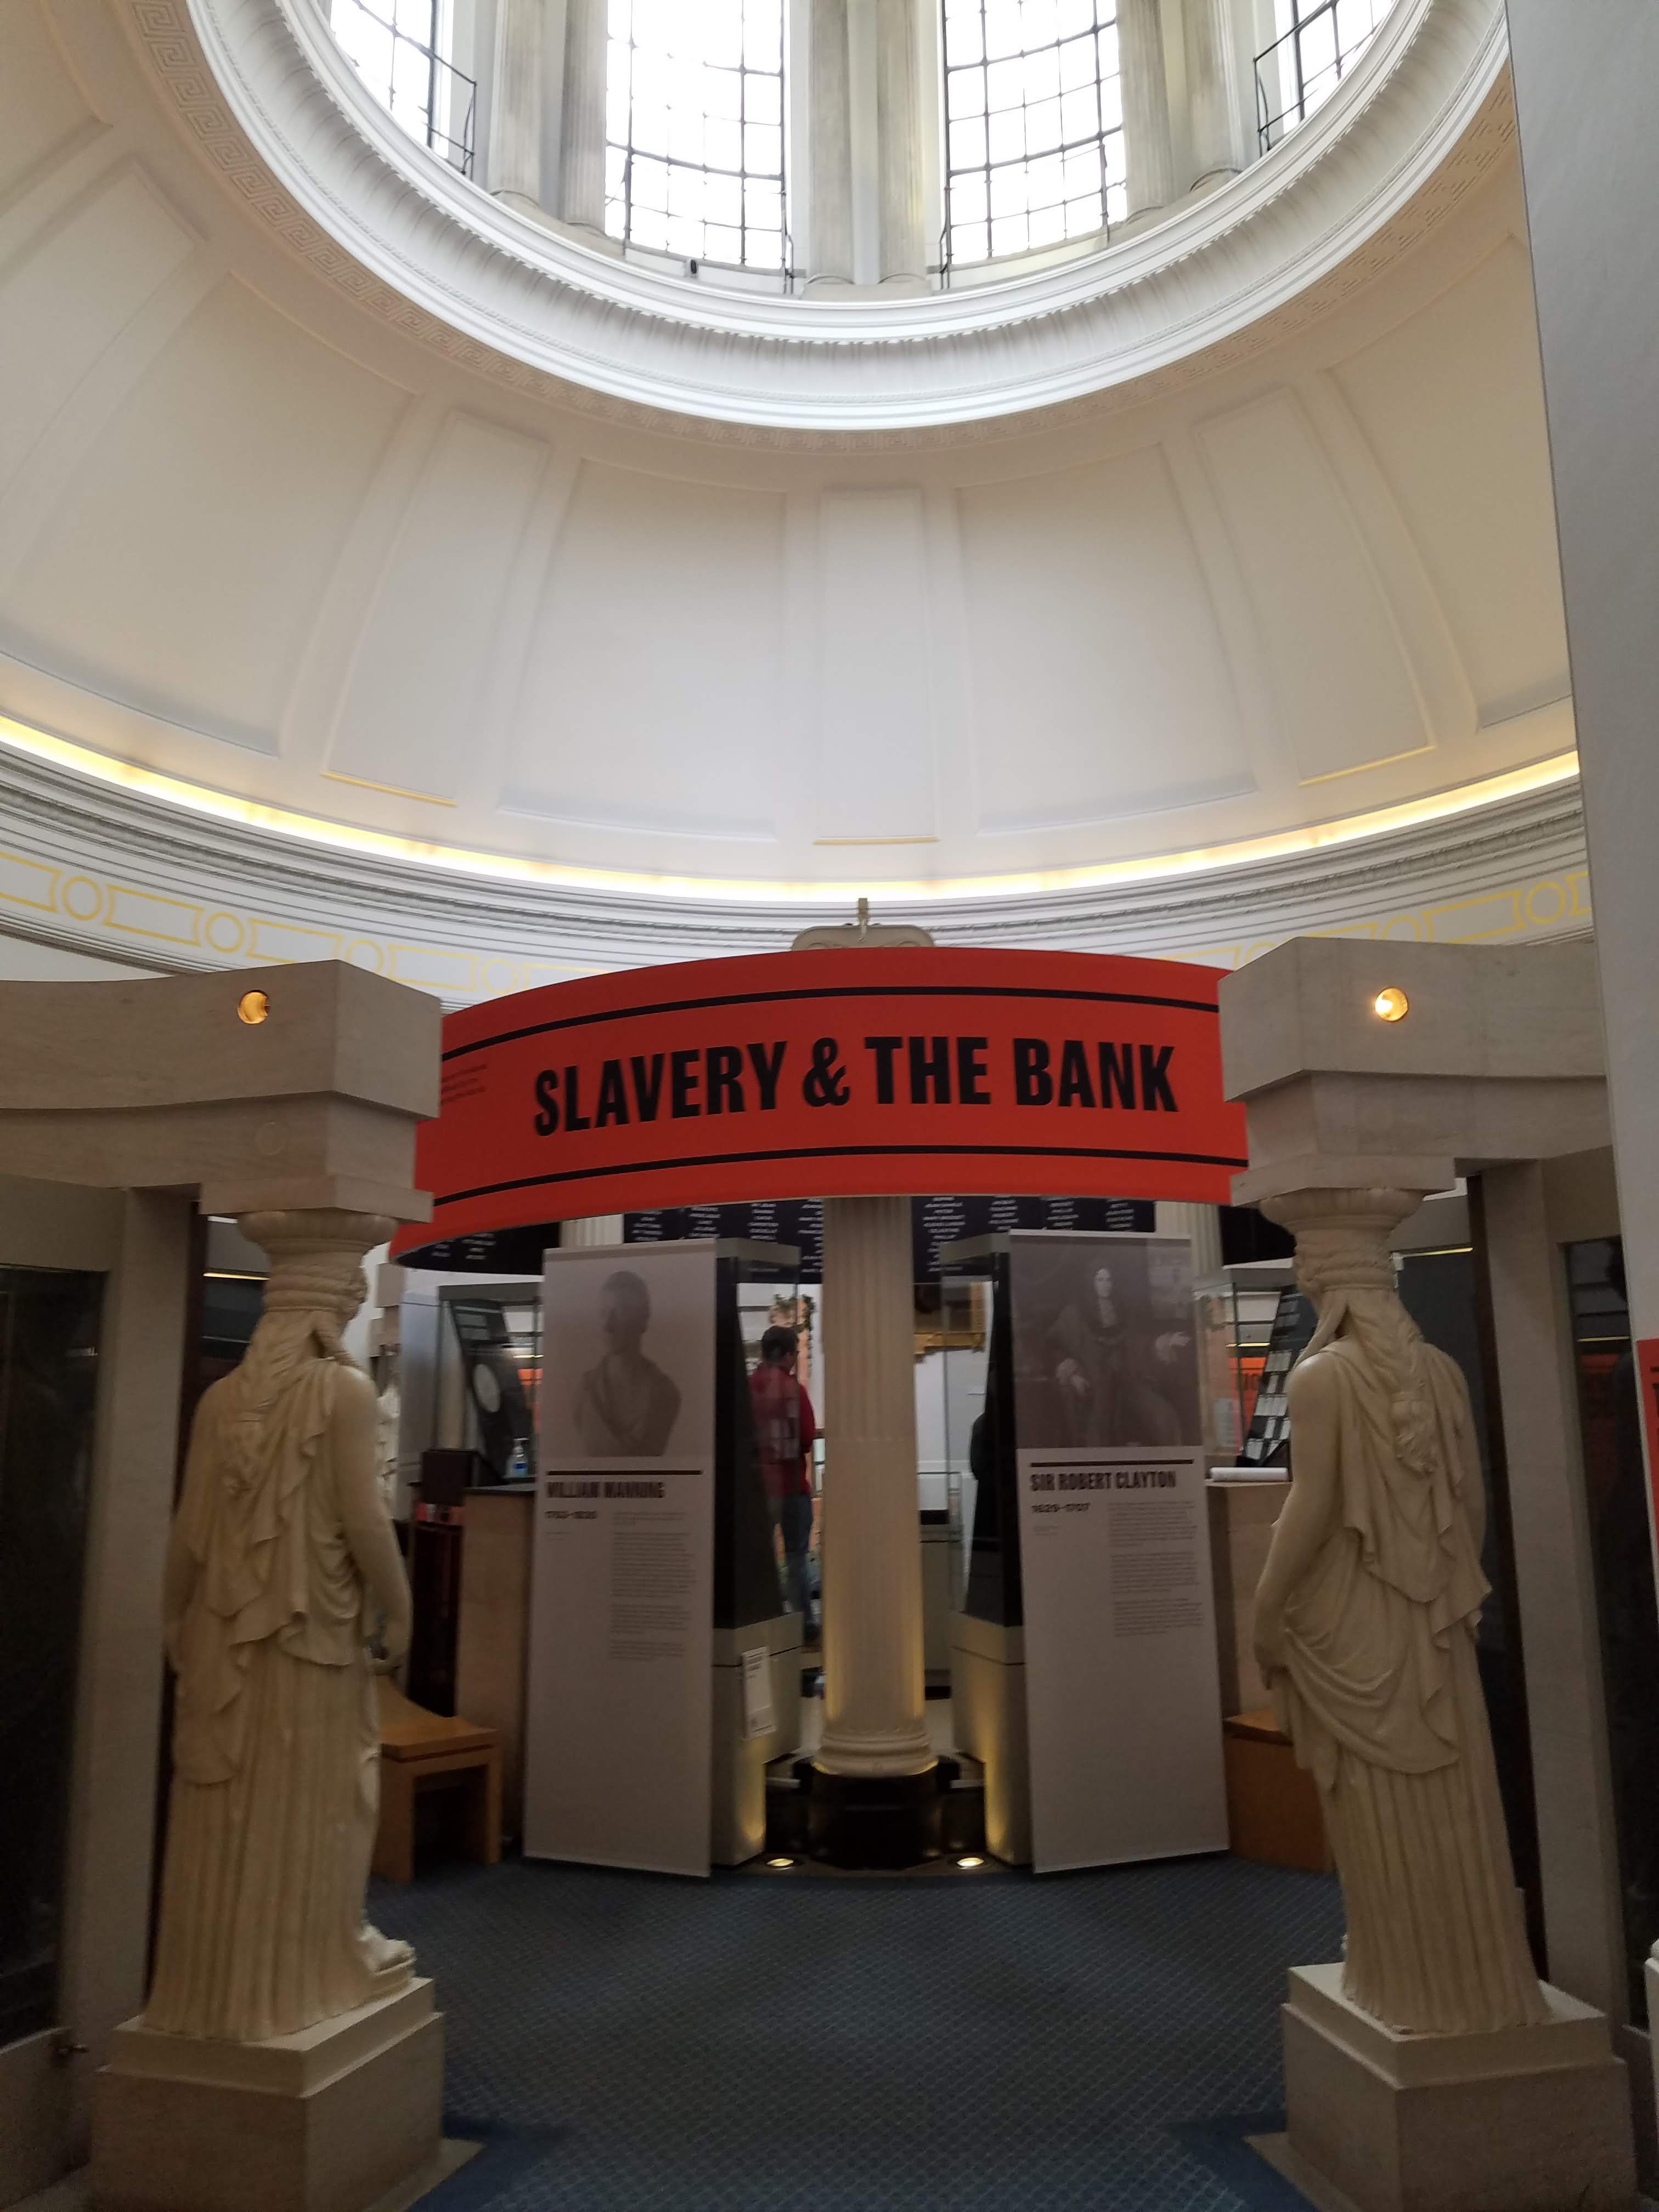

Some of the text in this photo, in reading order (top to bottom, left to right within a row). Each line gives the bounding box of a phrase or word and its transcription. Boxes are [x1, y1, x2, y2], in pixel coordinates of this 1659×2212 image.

[534, 1041, 787, 1137] SLAVERY
[802, 1037, 851, 1107] &
[864, 1036, 991, 1105] THE
[1012, 1037, 1180, 1113] BANK
[1030, 1471, 1176, 1491] SIR ROBERT CLAYTON
